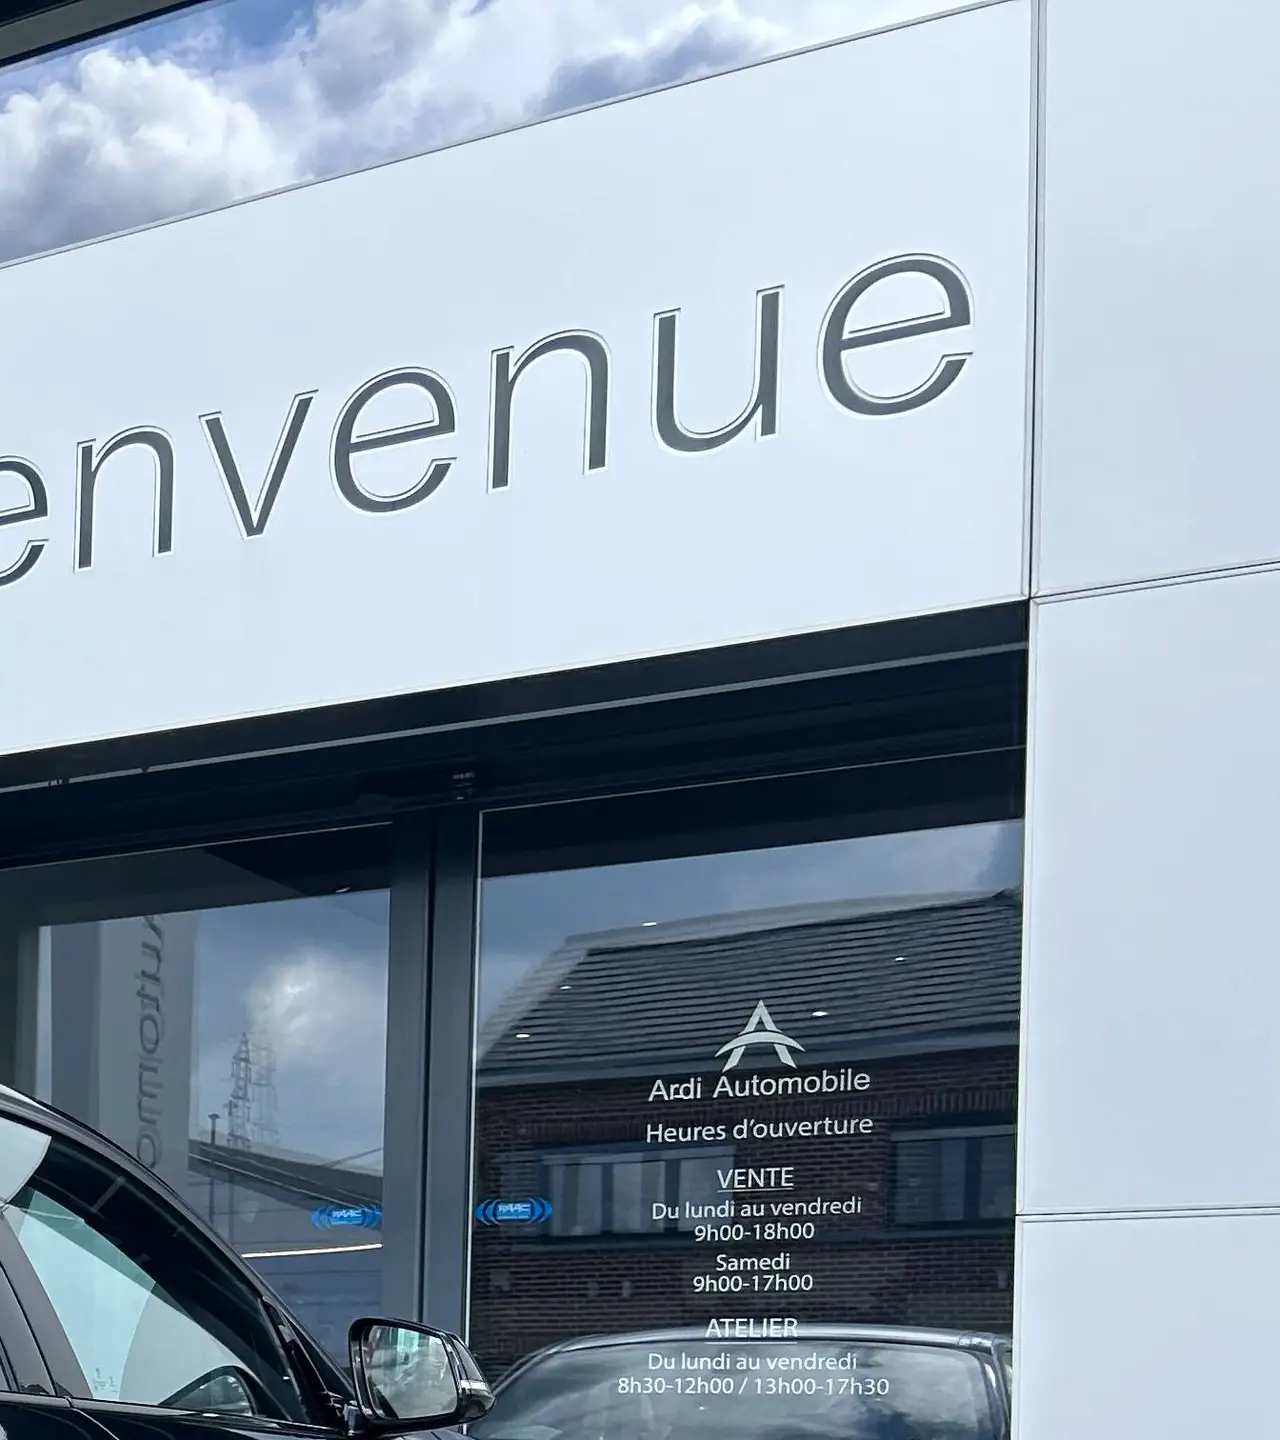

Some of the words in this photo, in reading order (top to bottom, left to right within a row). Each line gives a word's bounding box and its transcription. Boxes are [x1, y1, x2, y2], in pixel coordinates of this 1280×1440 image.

[648, 1077, 702, 1101] Ardi
[713, 1068, 871, 1098] Automobile
[646, 1123, 727, 1143] Heures
[732, 1117, 874, 1139] d'ouverture
[716, 1167, 794, 1189] VENTE
[652, 1203, 680, 1220] Du
[685, 1200, 735, 1219] lundi
[740, 1203, 765, 1218] au
[771, 1196, 862, 1217] vendredi
[694, 1222, 815, 1242] 9h00-18h00
[715, 1253, 791, 1272] Samedi
[692, 1274, 814, 1293] 9h00-17h00
[704, 1318, 799, 1338] ATELIER
[648, 1353, 679, 1371] Du
[681, 1352, 731, 1371] lundi
[736, 1356, 761, 1371] au
[766, 1352, 858, 1371] vendredi
[617, 1377, 734, 1395] 8h30-12h00
[755, 1377, 889, 1395] 13h00-17h30
